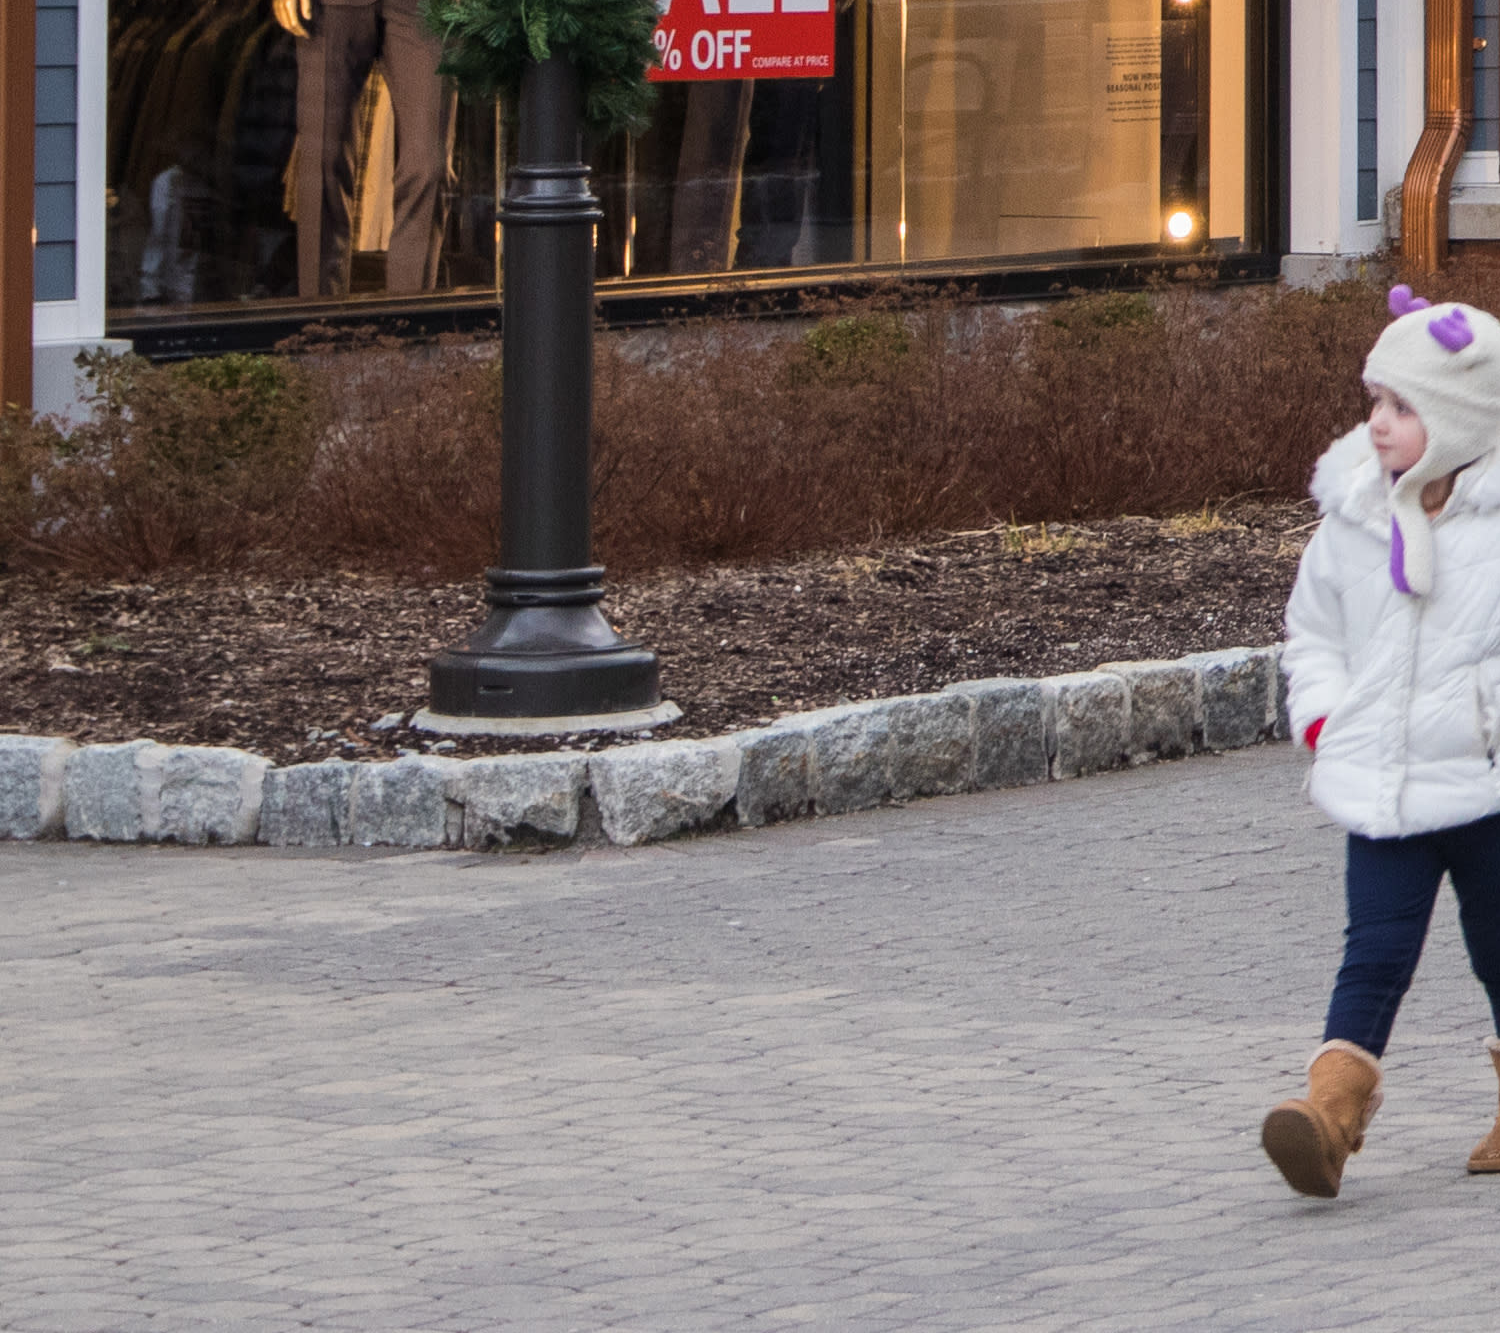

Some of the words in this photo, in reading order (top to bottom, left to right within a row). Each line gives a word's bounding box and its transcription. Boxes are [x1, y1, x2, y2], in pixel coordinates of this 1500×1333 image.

[691, 29, 752, 71] OFF
[793, 56, 804, 67] AT
[805, 55, 830, 68] PRICE
